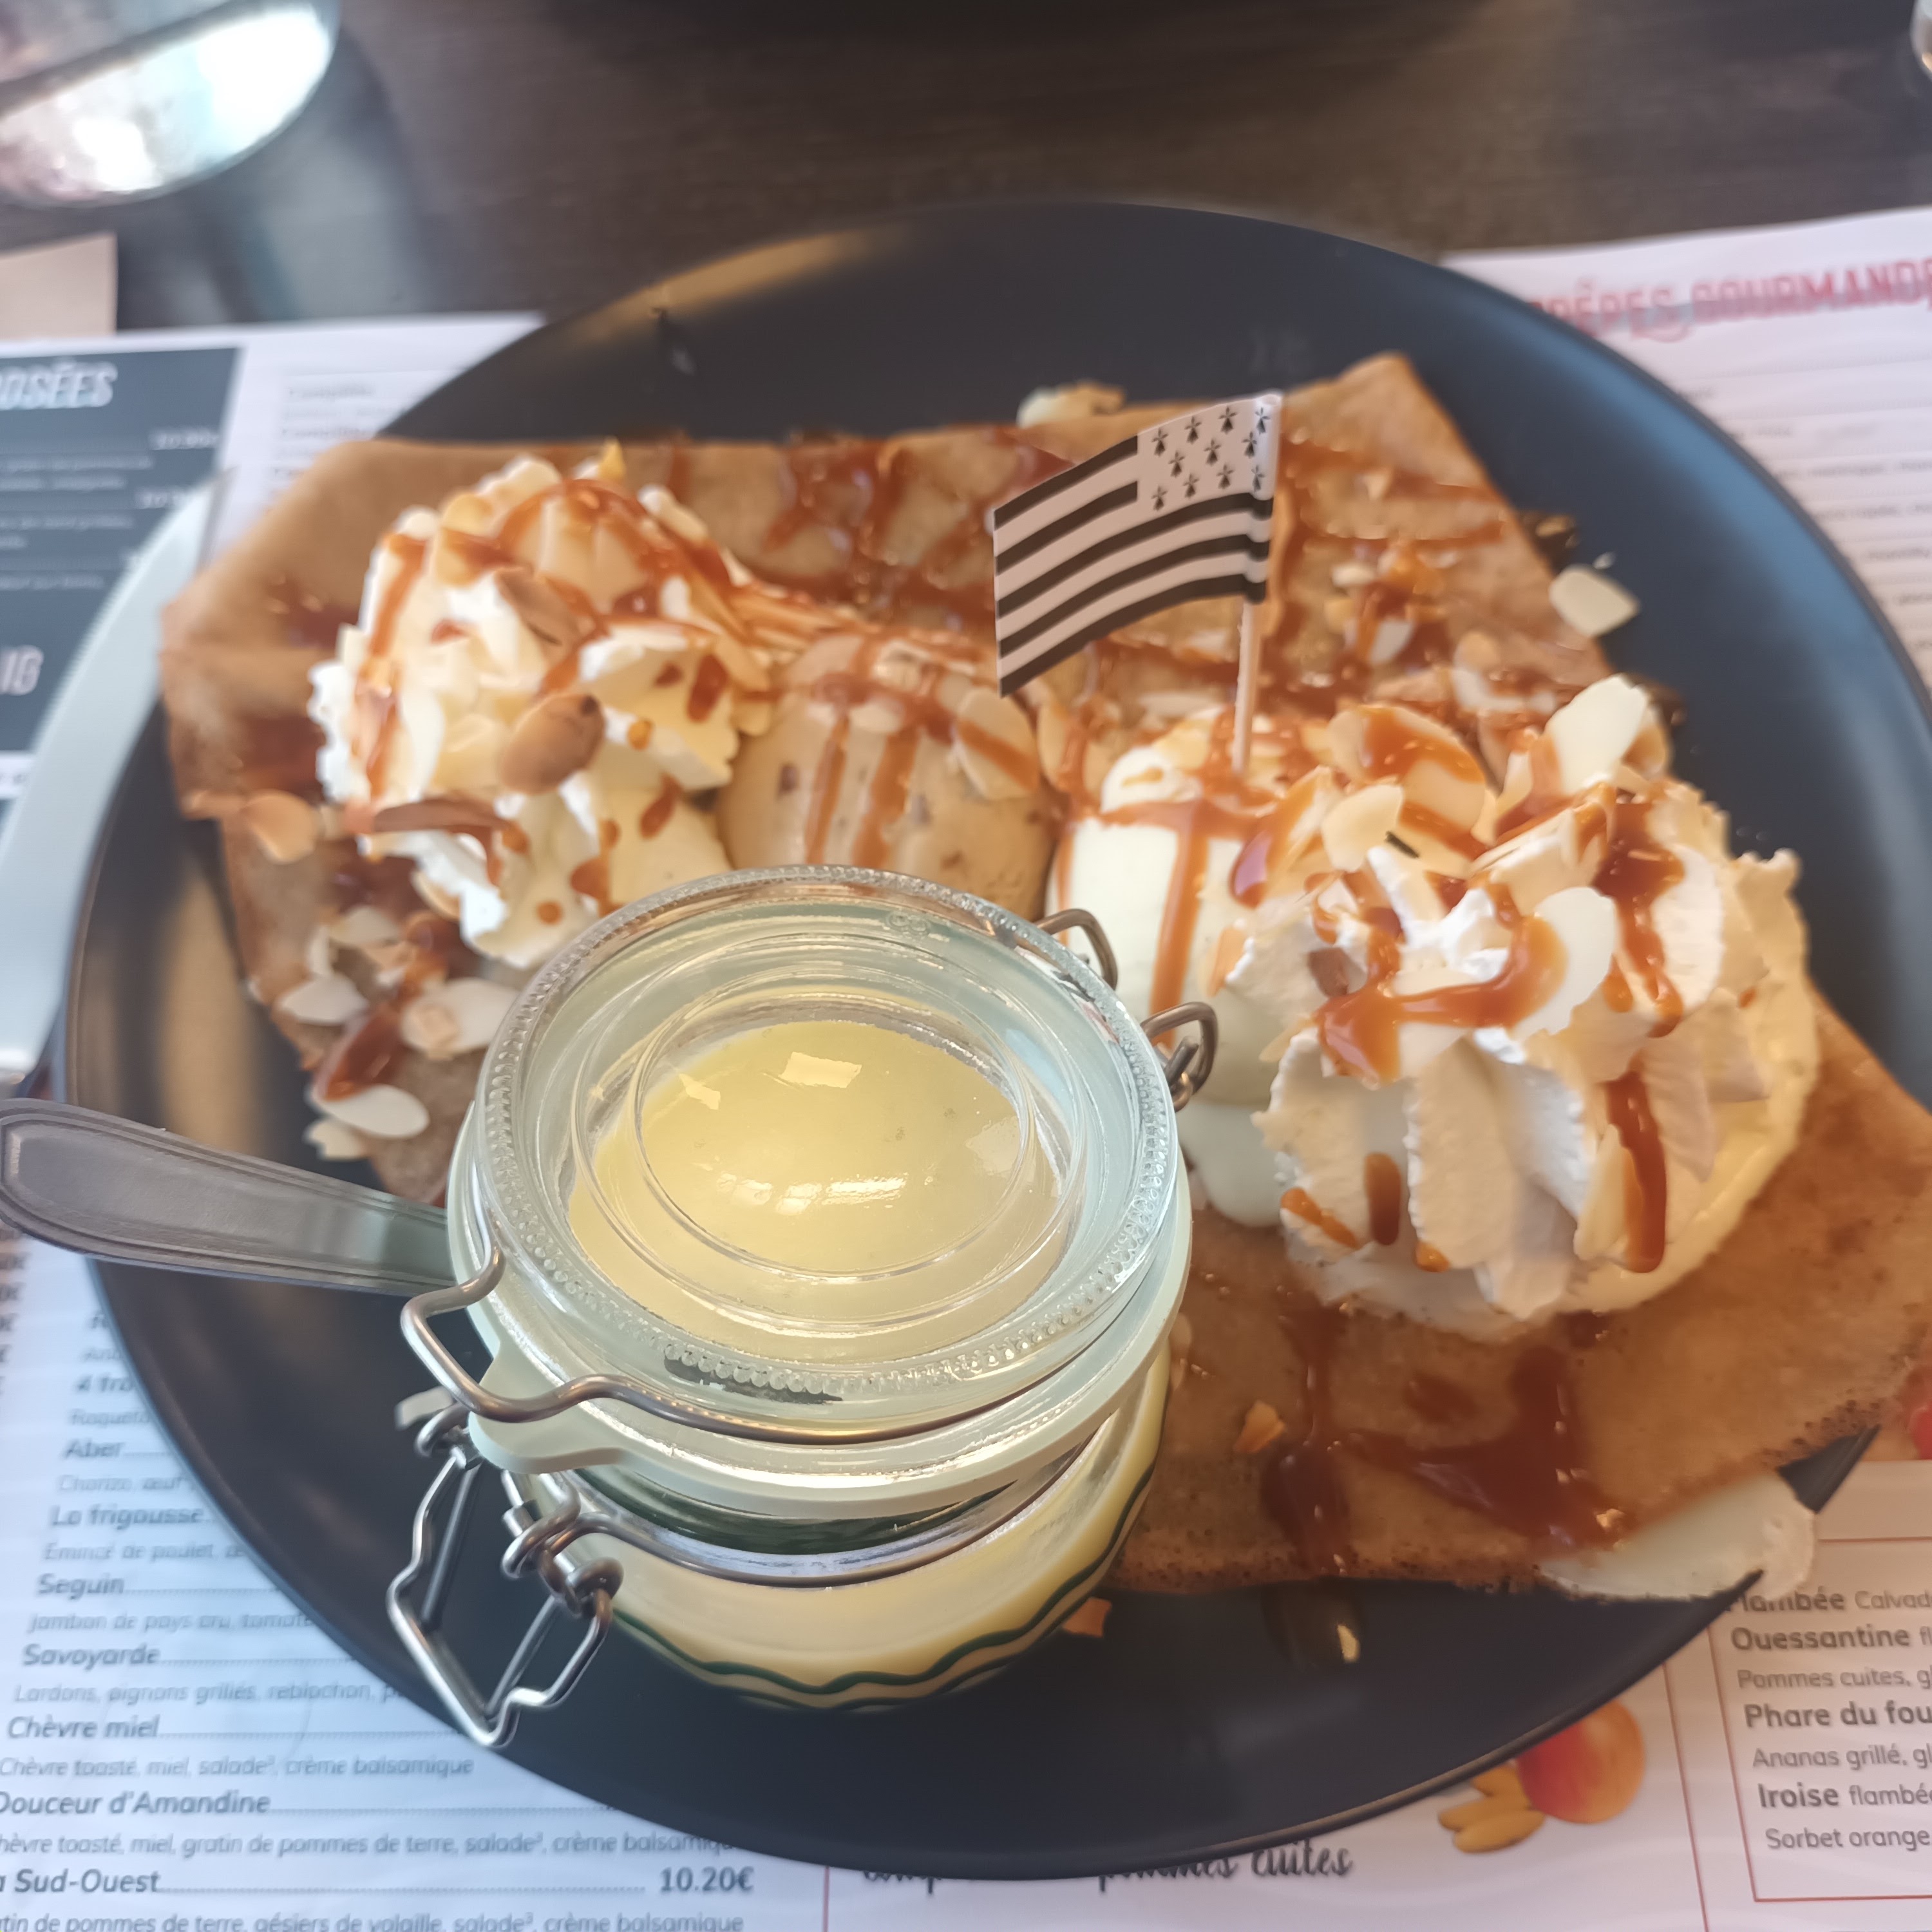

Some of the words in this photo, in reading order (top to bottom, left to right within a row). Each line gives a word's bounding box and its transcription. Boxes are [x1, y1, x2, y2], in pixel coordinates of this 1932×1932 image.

[37, 1573, 126, 1600] Seguin
[113, 1613, 137, 1630] de
[1730, 1623, 1910, 1650] Ouessantine
[22, 1643, 161, 1671] Savoyarde
[1737, 1669, 1835, 1689] Pommes
[1839, 1667, 1912, 1688] cuites,
[7, 1714, 99, 1739] Chèvre
[103, 1714, 161, 1738] miel
[1743, 1702, 1831, 1728] Phare
[1840, 1700, 1877, 1726] du
[1885, 1700, 1932, 1724] fou
[354, 1754, 475, 1779] balsamique
[1752, 1747, 1841, 1768] Ananas
[108, 1789, 270, 1814] d'Amandine
[1757, 1781, 1840, 1808] Iroise
[181, 1834, 243, 1859] gratin
[247, 1833, 275, 1854] de
[276, 1837, 369, 1859] pommes
[374, 1833, 401, 1854] de
[1765, 1827, 1844, 1850] Sorbet
[14, 1868, 161, 1894] Sud-Ouest
[659, 1866, 755, 1893] 10.20€
[35, 1913, 61, 1932] de
[65, 1917, 156, 1932] pommes
[162, 1913, 189, 1932] de
[335, 1913, 363, 1932] de
